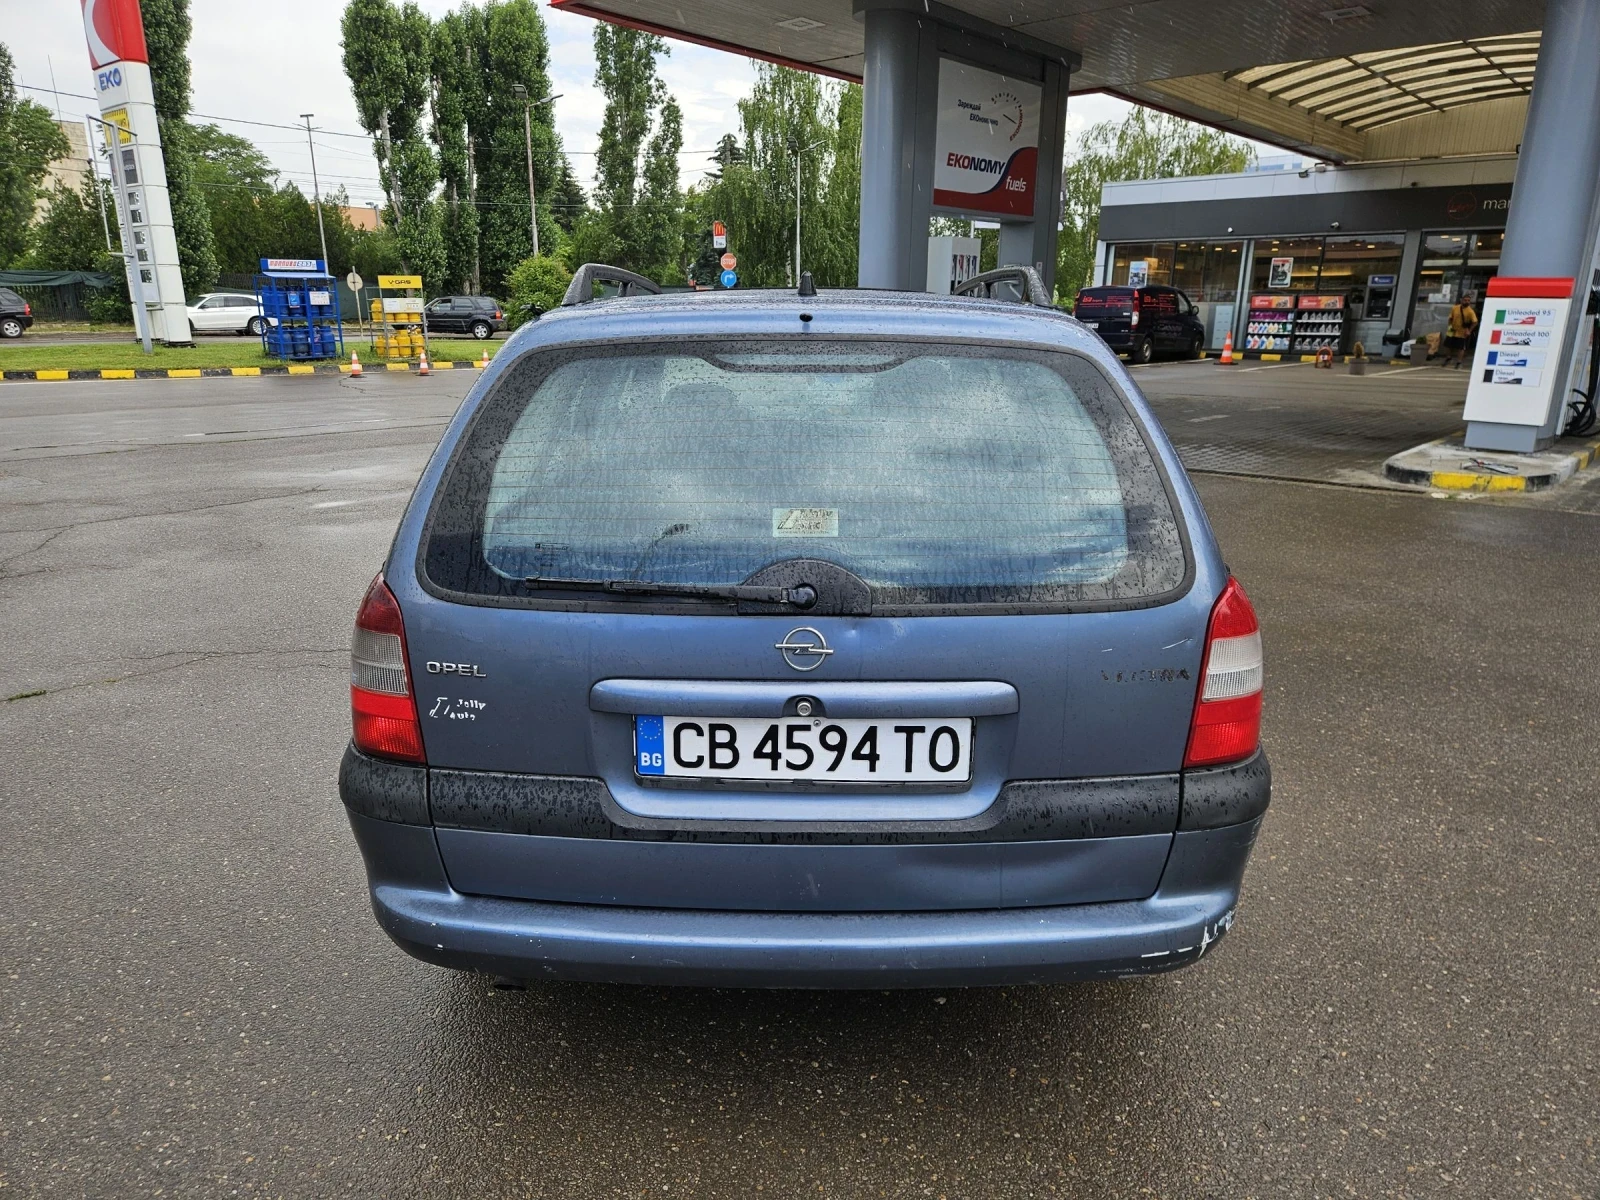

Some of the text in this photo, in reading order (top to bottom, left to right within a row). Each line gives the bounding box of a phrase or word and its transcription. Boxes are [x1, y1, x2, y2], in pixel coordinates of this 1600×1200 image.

[98, 68, 122, 91] EKO
[957, 99, 982, 111] Зареждай
[946, 152, 1027, 192] EKONOMY fuels
[1495, 369, 1515, 377] Diesel
[426, 661, 487, 677] OPEL
[673, 722, 961, 773] CB 4594 TO
[640, 752, 663, 767] BG
